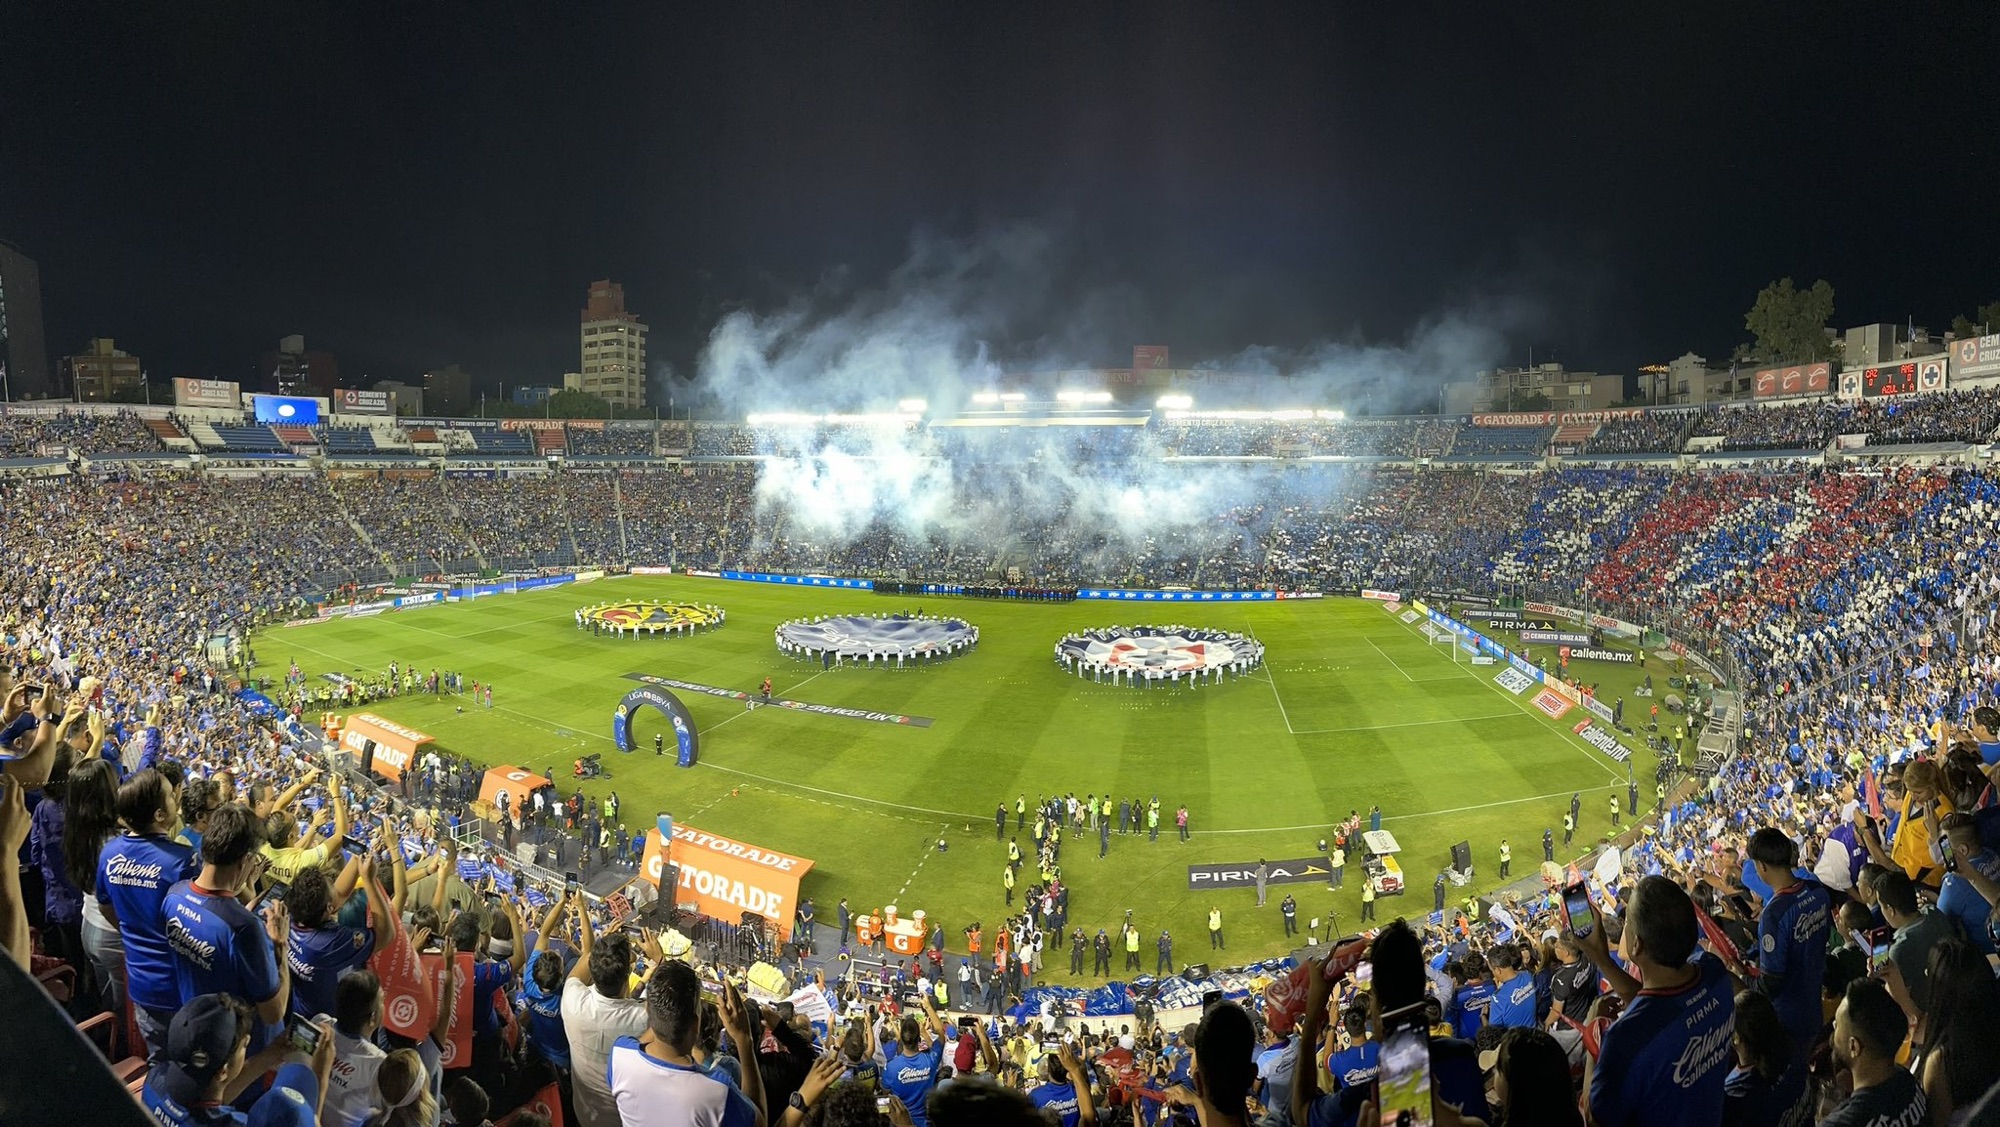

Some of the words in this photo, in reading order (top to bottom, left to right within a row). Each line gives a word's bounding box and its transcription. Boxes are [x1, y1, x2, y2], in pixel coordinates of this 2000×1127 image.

[358, 391, 387, 400] CEMENTO
[1882, 385, 1898, 394] AZUL
[510, 420, 564, 430] GATORADE
[1354, 419, 1398, 427] caliente.mx
[1483, 415, 1544, 425] GATORADE
[1561, 411, 1629, 424] GATORADE
[1525, 602, 1554, 613] GONHER
[1490, 620, 1537, 630] PIRMA
[1592, 615, 1619, 629] GONHER
[1574, 634, 1588, 642] AZUL
[1571, 648, 1633, 662] caliente.mx
[628, 692, 644, 701] LIGA
[651, 694, 670, 710] BBVA
[1539, 694, 1562, 712] BIMBO
[359, 714, 427, 742] GATORADE
[346, 730, 409, 770] GATRADE
[1580, 725, 1631, 762] caliente.mx
[670, 826, 798, 872] GATORADE
[106, 854, 162, 880] Caliente
[109, 875, 158, 888] caliente.mx
[648, 855, 783, 920] GTORADE
[1798, 894, 1816, 909] PIRMA
[176, 903, 202, 923] PIRMA
[166, 916, 216, 958] Caliente
[894, 934, 908, 950] G
[1686, 997, 1720, 1029] PIRMA
[898, 1066, 931, 1081] Caliente
